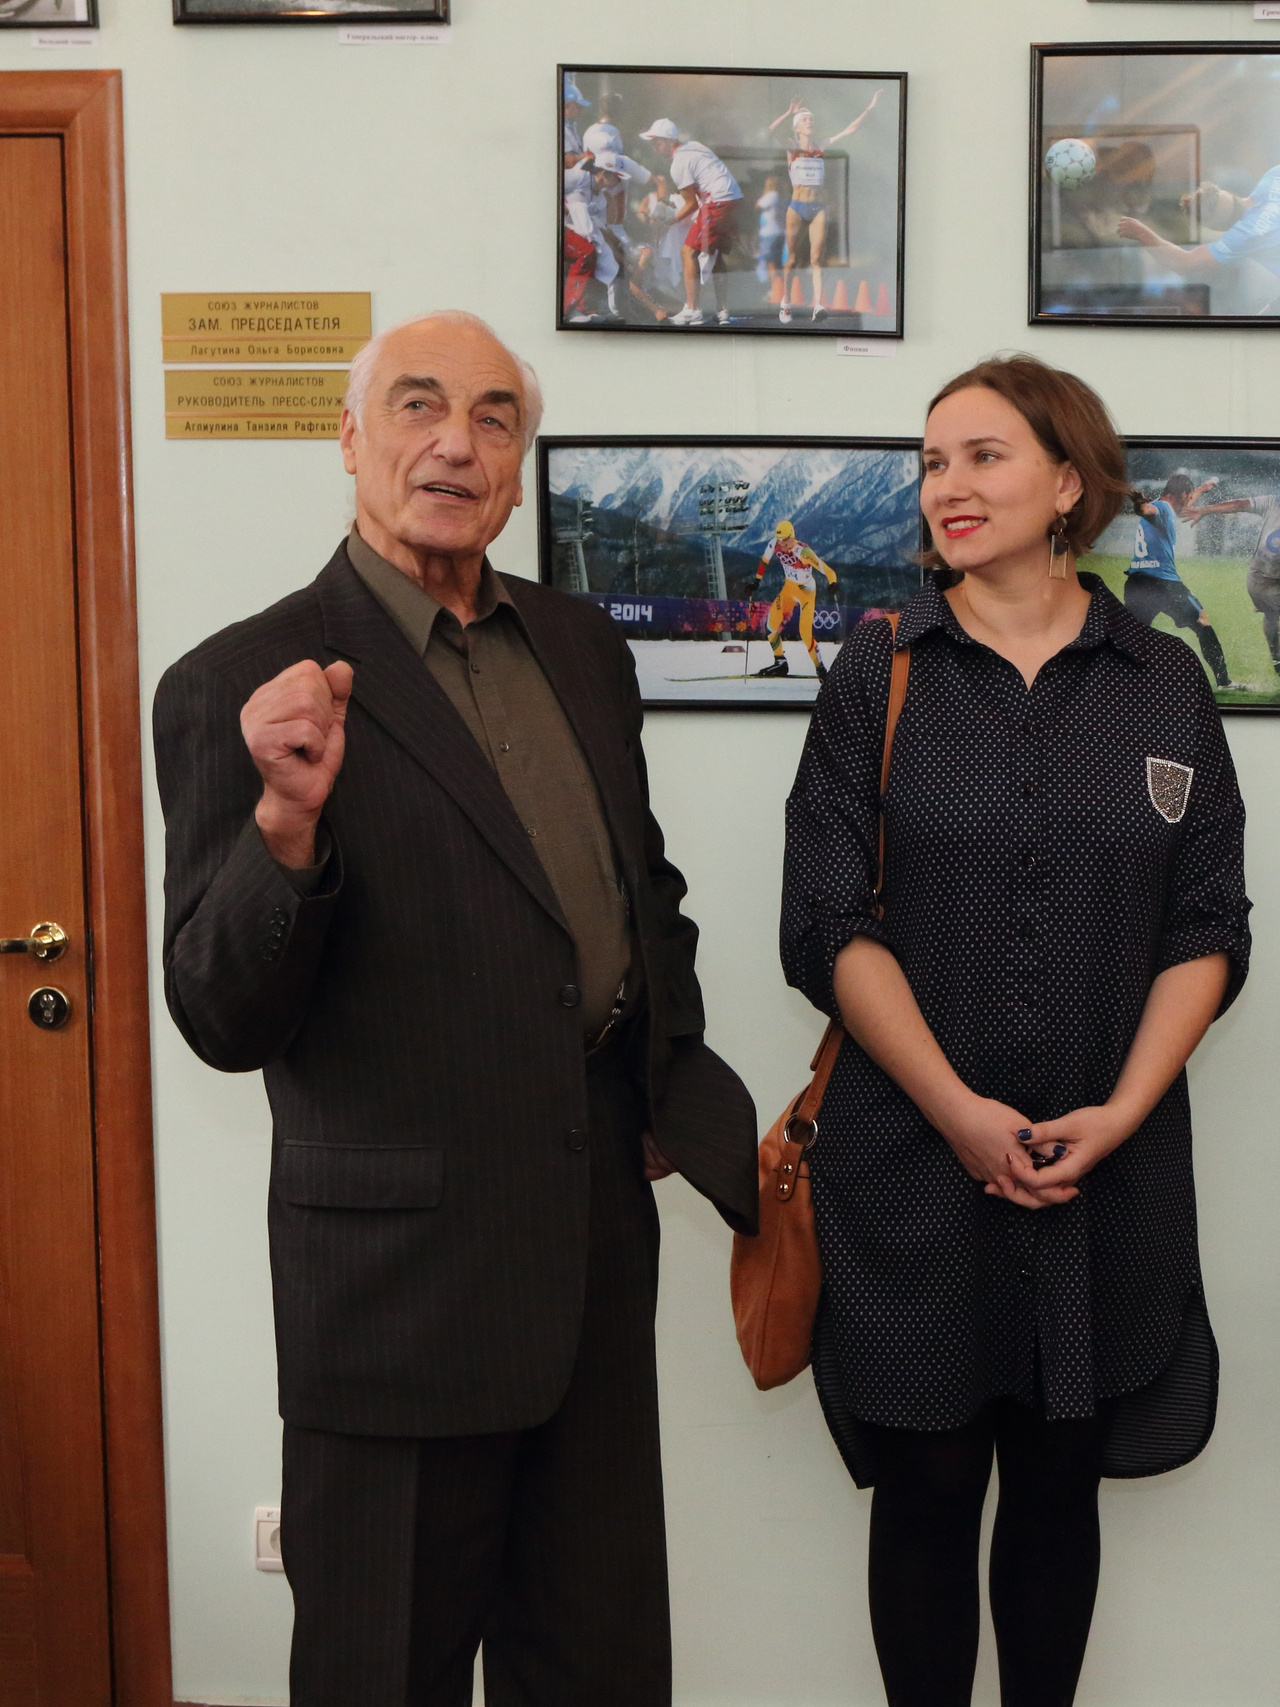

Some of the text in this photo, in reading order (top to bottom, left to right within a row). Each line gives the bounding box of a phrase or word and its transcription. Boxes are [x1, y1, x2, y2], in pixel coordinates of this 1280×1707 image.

[208, 300, 319, 311] СОЮЗ ЖУРНАЛИСТОВ
[188, 316, 341, 332] ЗАМ. ПРЕДСЕДАТЕЛЯ
[191, 343, 344, 357] Лагутина Ольга Борисовна
[213, 376, 324, 387] СОЮЗ ЖУРНАЛИСТОВ
[177, 396, 344, 408] РУКОВОДИТЕЛЬ ПРЕСС-СЛУЖ
[184, 420, 341, 434] Аглиулина Танзиля Рафгато
[610, 603, 653, 622] 2014
